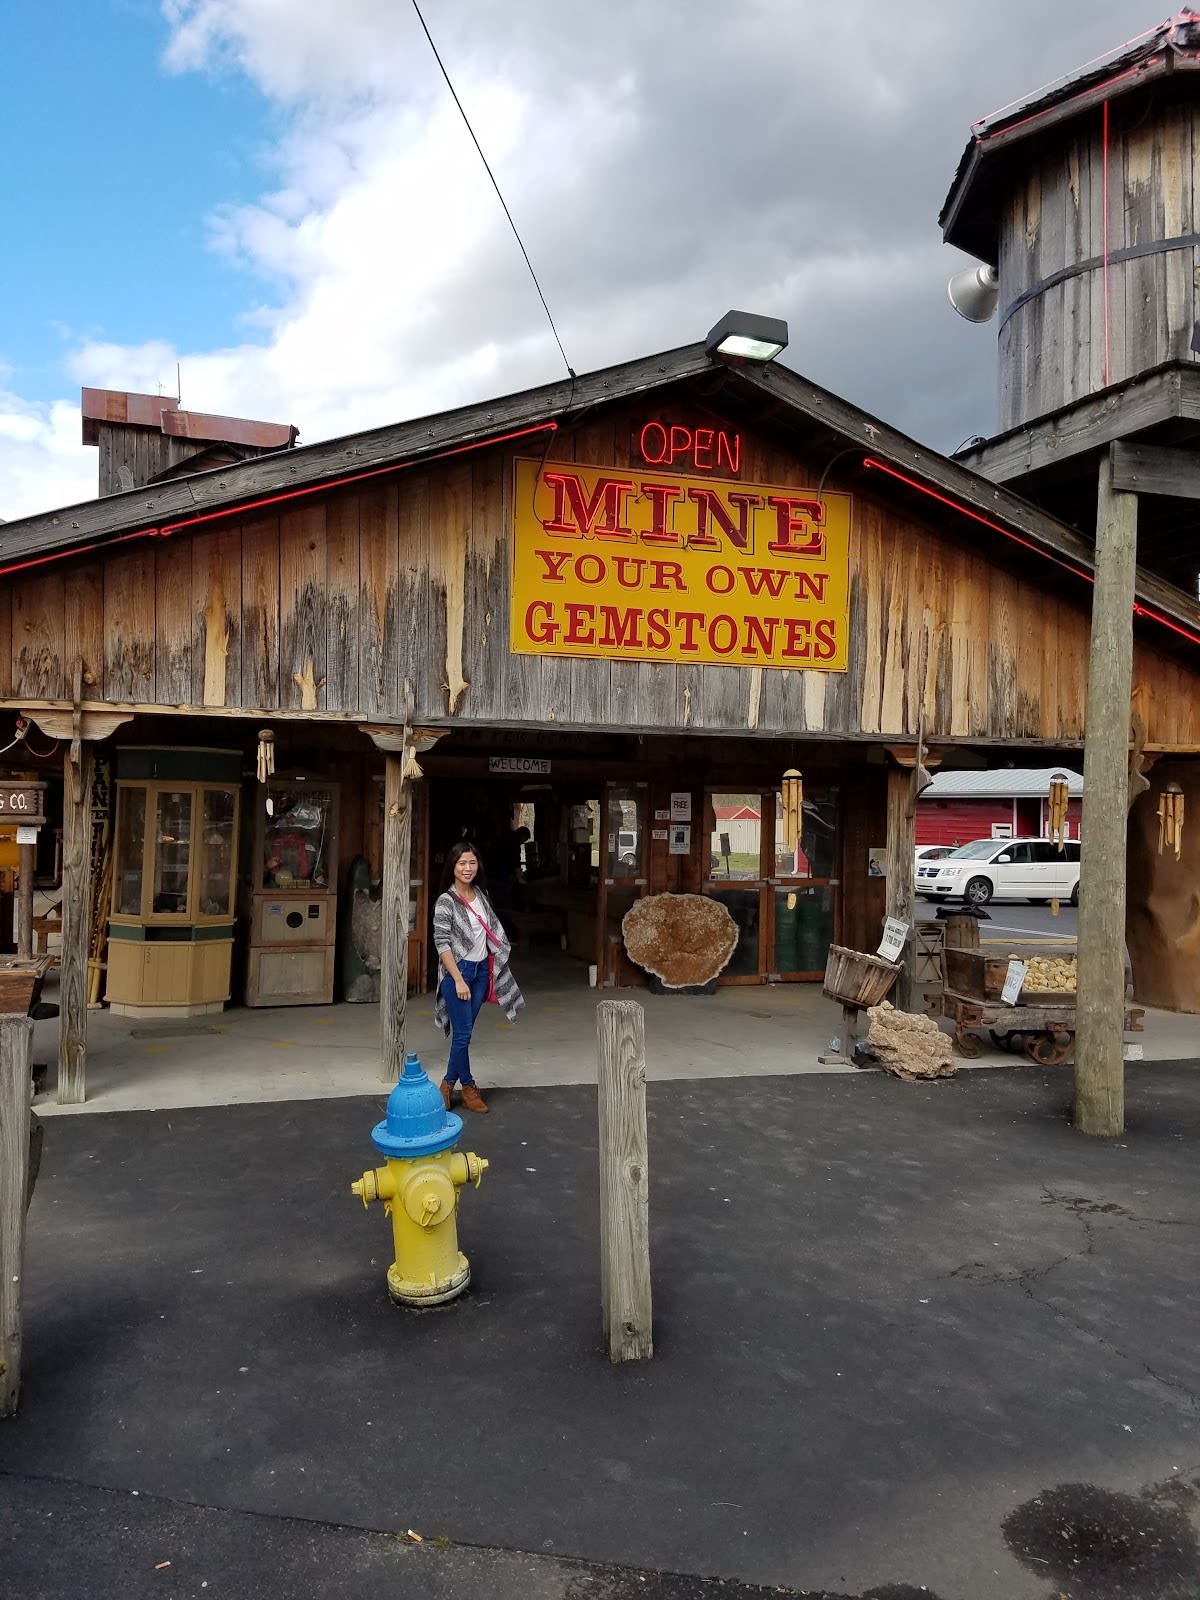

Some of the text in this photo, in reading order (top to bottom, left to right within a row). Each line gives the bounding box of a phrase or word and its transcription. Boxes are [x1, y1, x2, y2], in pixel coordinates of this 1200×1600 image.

[640, 422, 740, 473] OPEN
[542, 472, 825, 557] MINE
[534, 550, 830, 601] YOUR OWN
[524, 601, 837, 660] GEMSTONES
[9, 793, 28, 810] CO.
